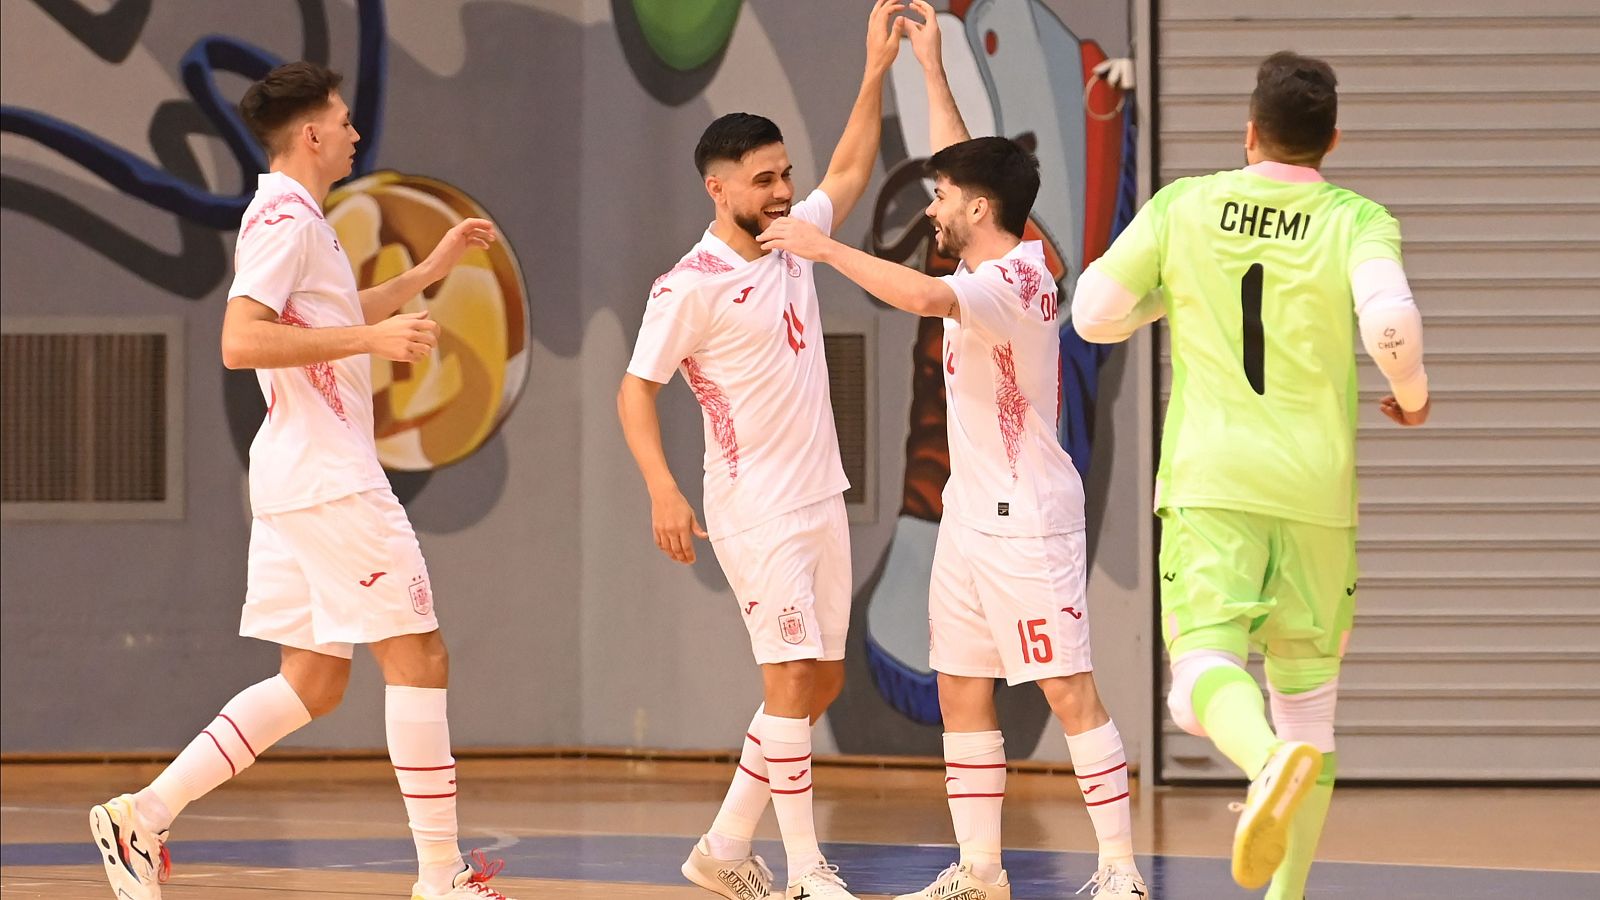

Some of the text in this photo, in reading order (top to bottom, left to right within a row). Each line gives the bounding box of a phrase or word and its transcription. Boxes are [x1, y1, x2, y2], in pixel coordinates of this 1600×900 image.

[1220, 201, 1311, 241] CHEMI
[1241, 263, 1265, 395] 1
[1378, 338, 1404, 349] CHEMI
[1391, 351, 1397, 360] 1
[1018, 618, 1053, 664] 15
[718, 869, 756, 900] MUNIC
